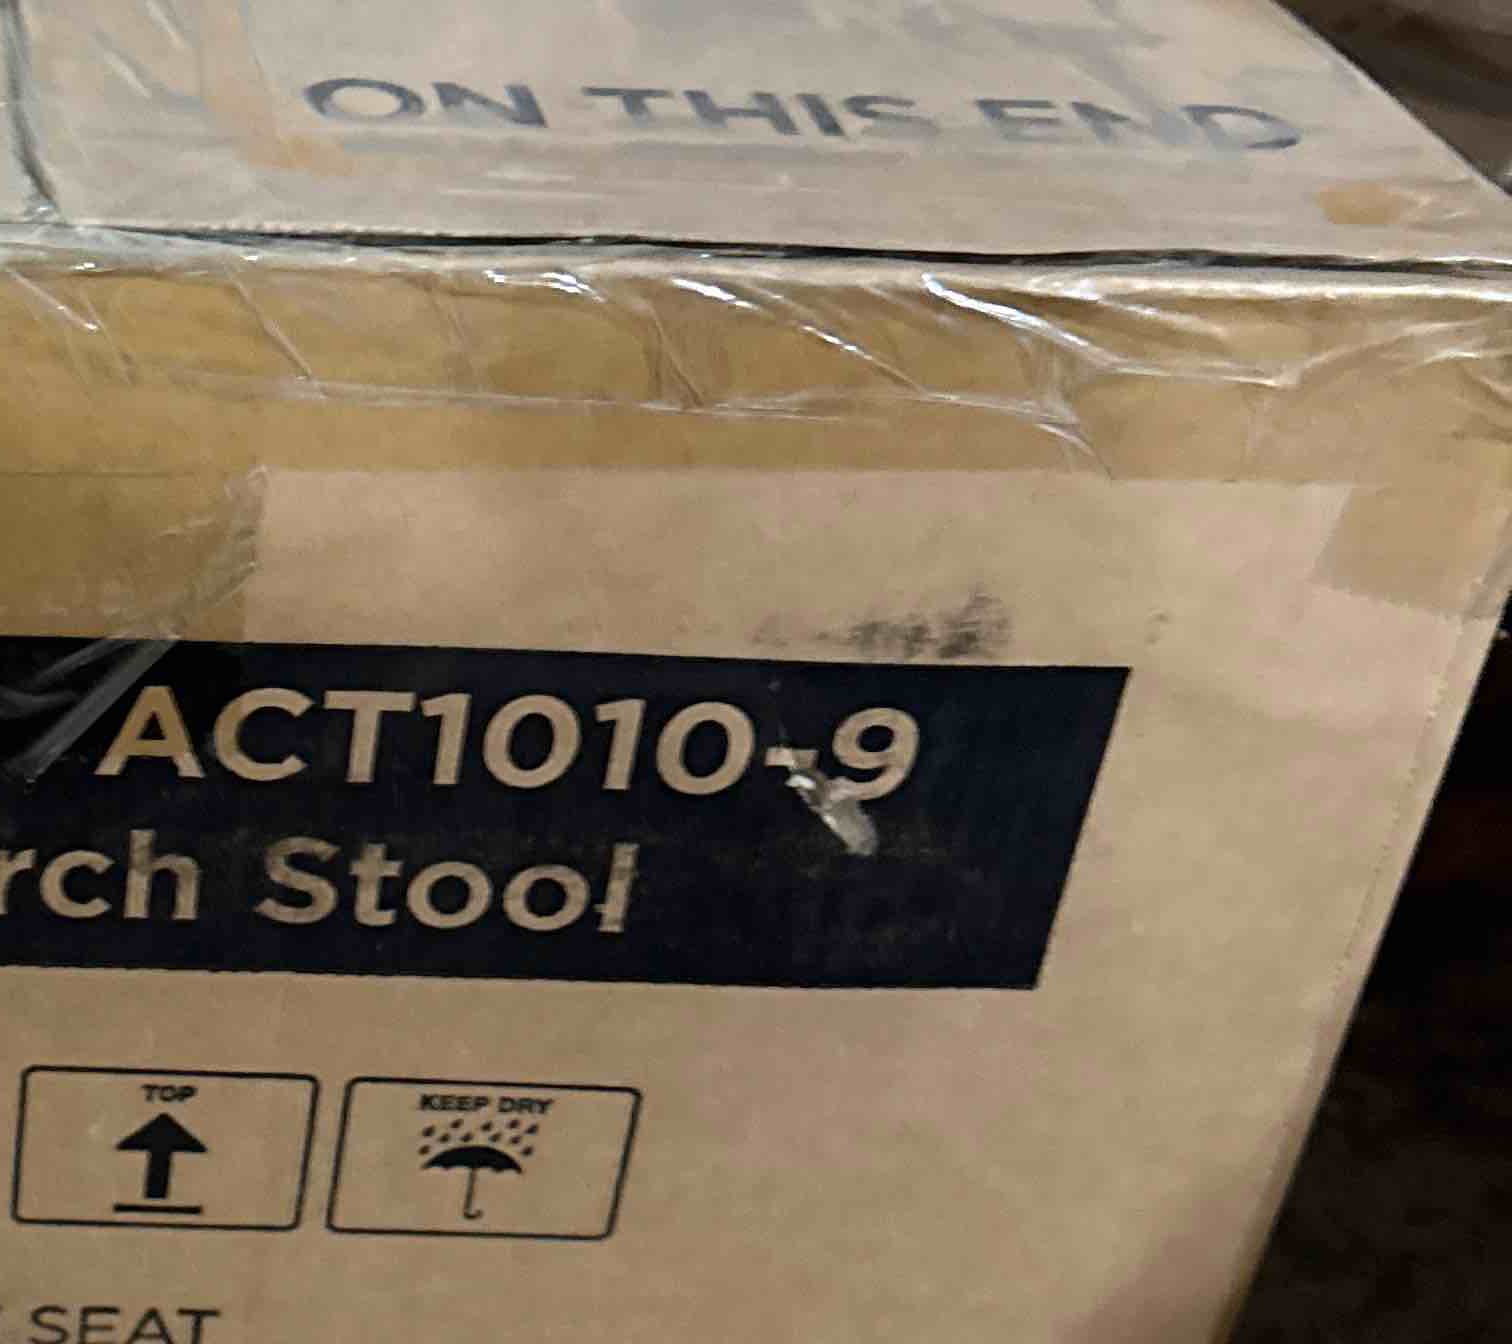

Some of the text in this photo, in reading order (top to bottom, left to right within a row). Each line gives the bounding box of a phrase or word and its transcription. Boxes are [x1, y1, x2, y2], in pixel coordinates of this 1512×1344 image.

[302, 76, 1303, 152] ON THIS END
[94, 683, 922, 803] ACT1010-9
[254, 838, 642, 934] Stool
[141, 1083, 198, 1105] TOP
[419, 1092, 554, 1115] KEEP DRY
